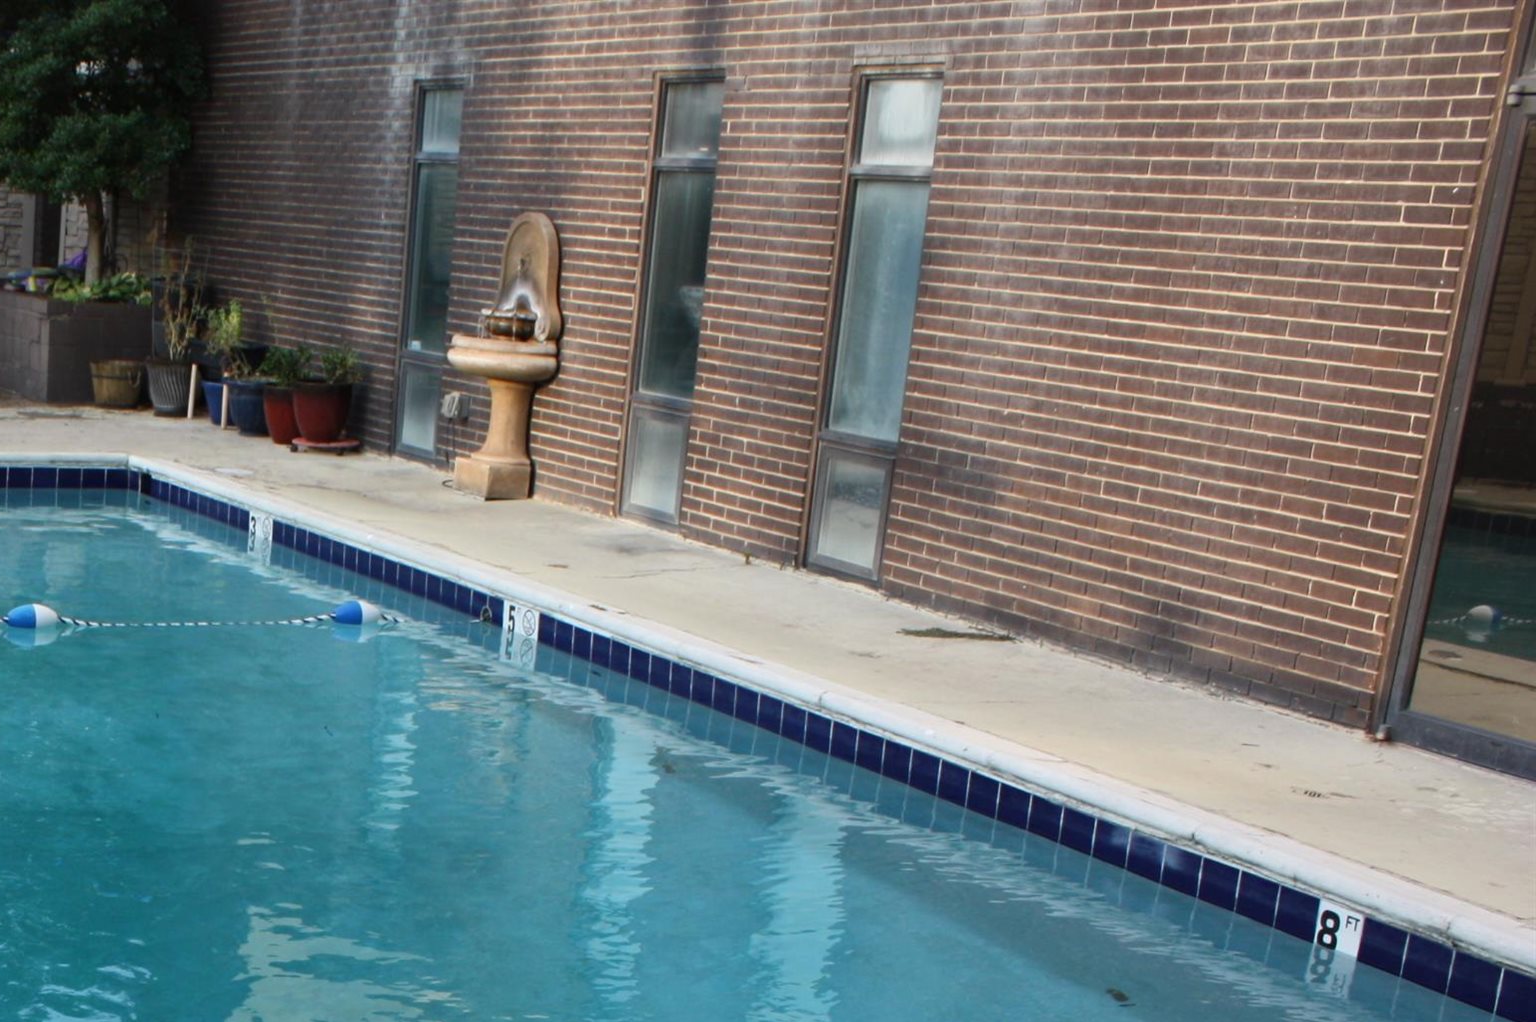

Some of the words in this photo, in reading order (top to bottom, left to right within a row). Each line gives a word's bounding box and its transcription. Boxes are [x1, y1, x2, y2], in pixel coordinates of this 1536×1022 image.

[251, 516, 256, 535] 3
[508, 605, 515, 633] 5
[1317, 910, 1340, 950] 8
[1345, 916, 1360, 932] FT
